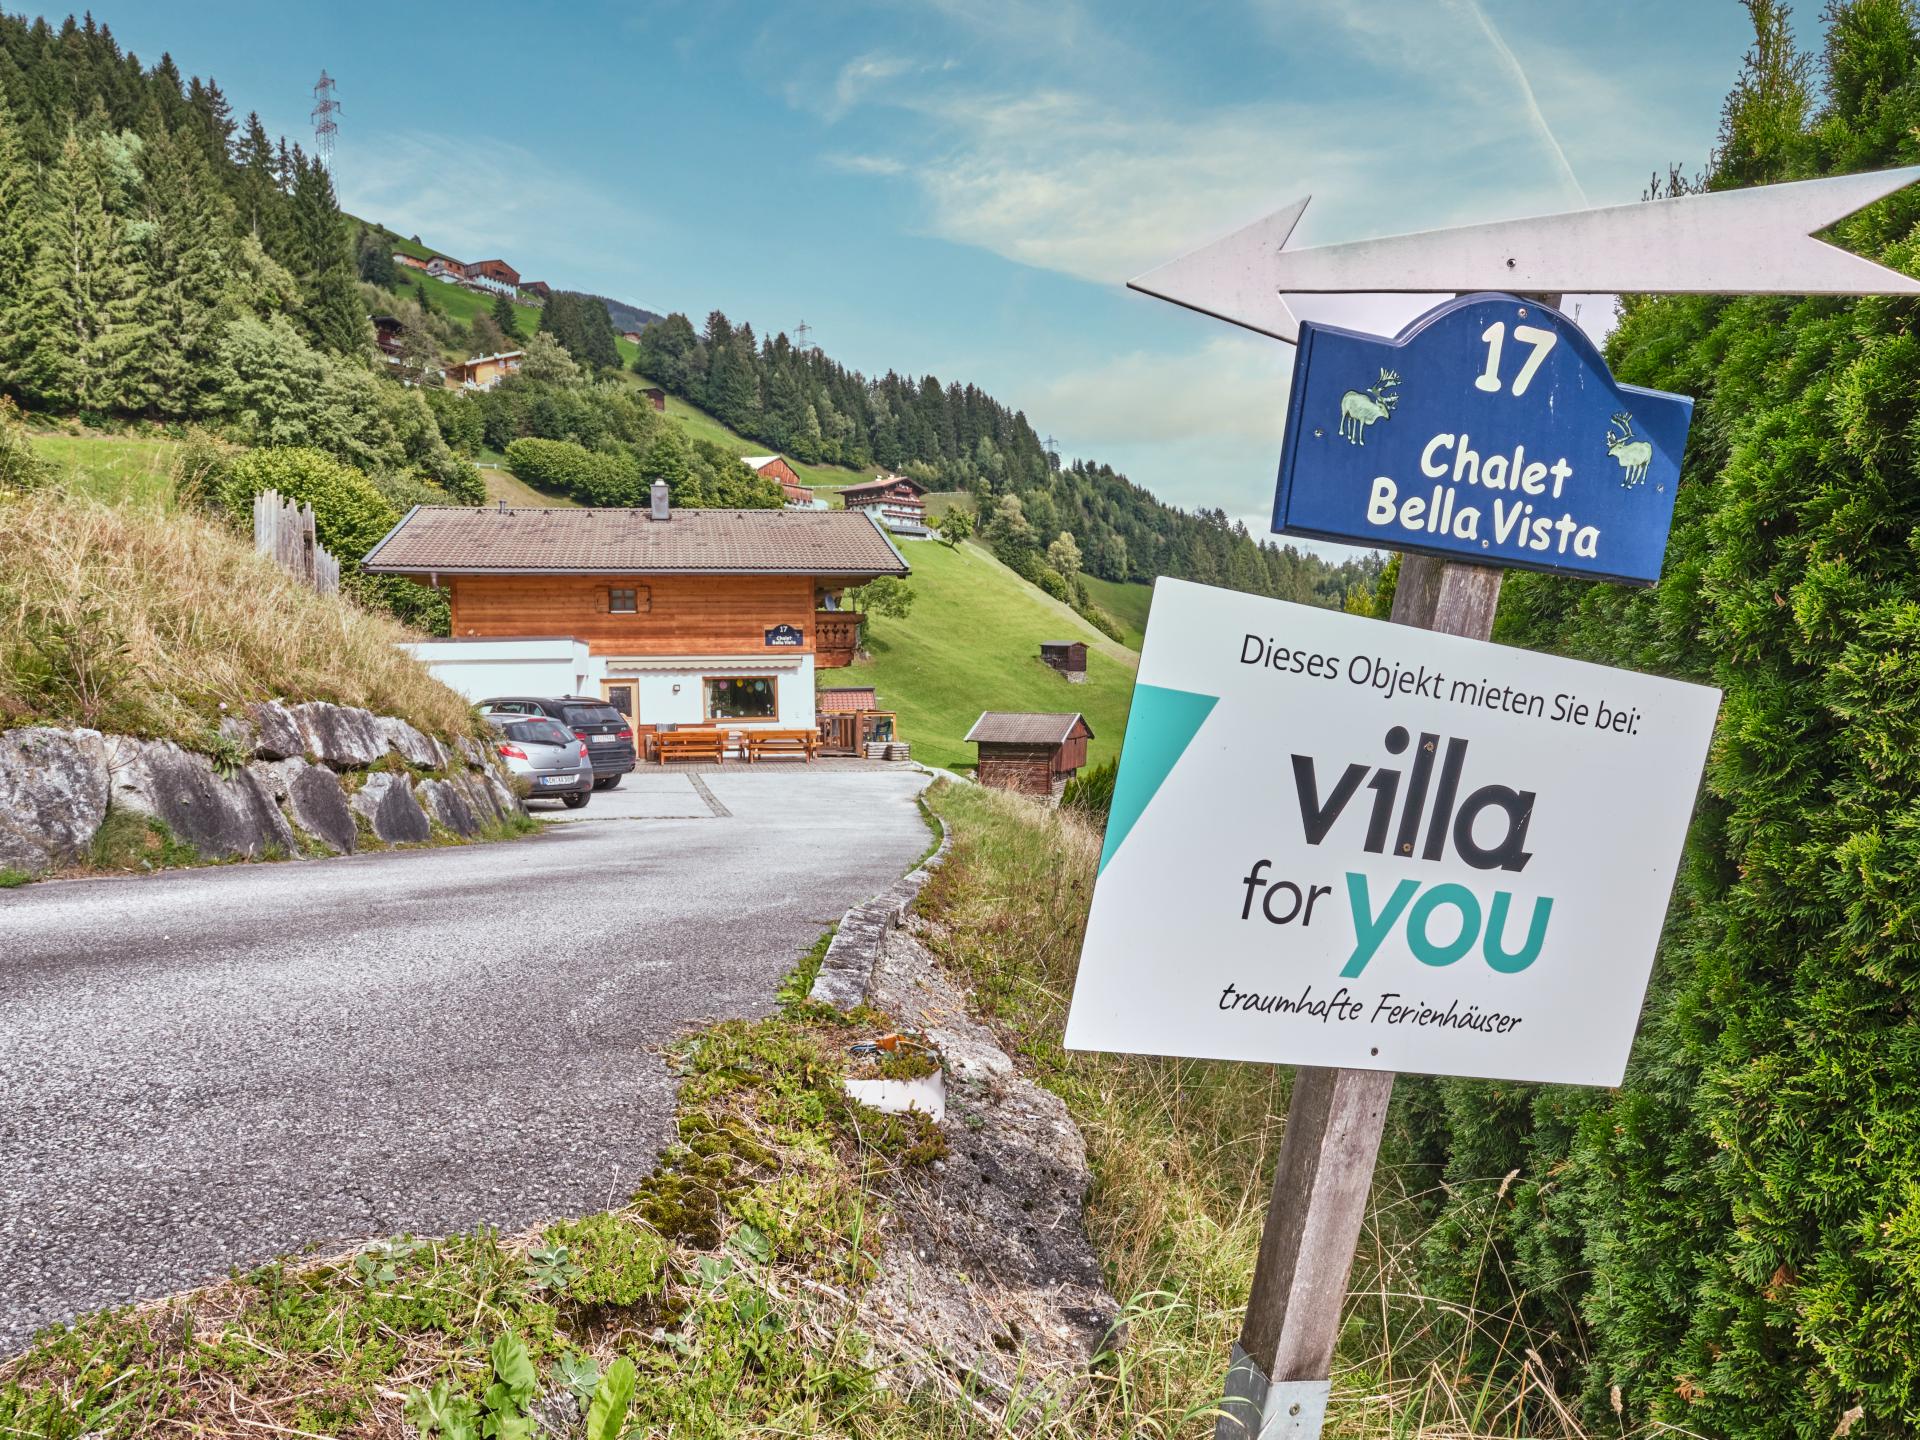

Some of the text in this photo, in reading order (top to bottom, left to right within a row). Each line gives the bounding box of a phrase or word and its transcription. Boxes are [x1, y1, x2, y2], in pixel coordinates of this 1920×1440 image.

[1474, 321, 1558, 397] 17
[1420, 433, 1573, 499] Chalet
[1366, 476, 1601, 559] Bella Vista
[1240, 633, 1642, 736] Dieses Objekt mieten Sie bei:
[1290, 725, 1537, 873] villa
[1241, 859, 1554, 979] for you
[1219, 982, 1523, 1034] traumhafte Ferienhäuser
